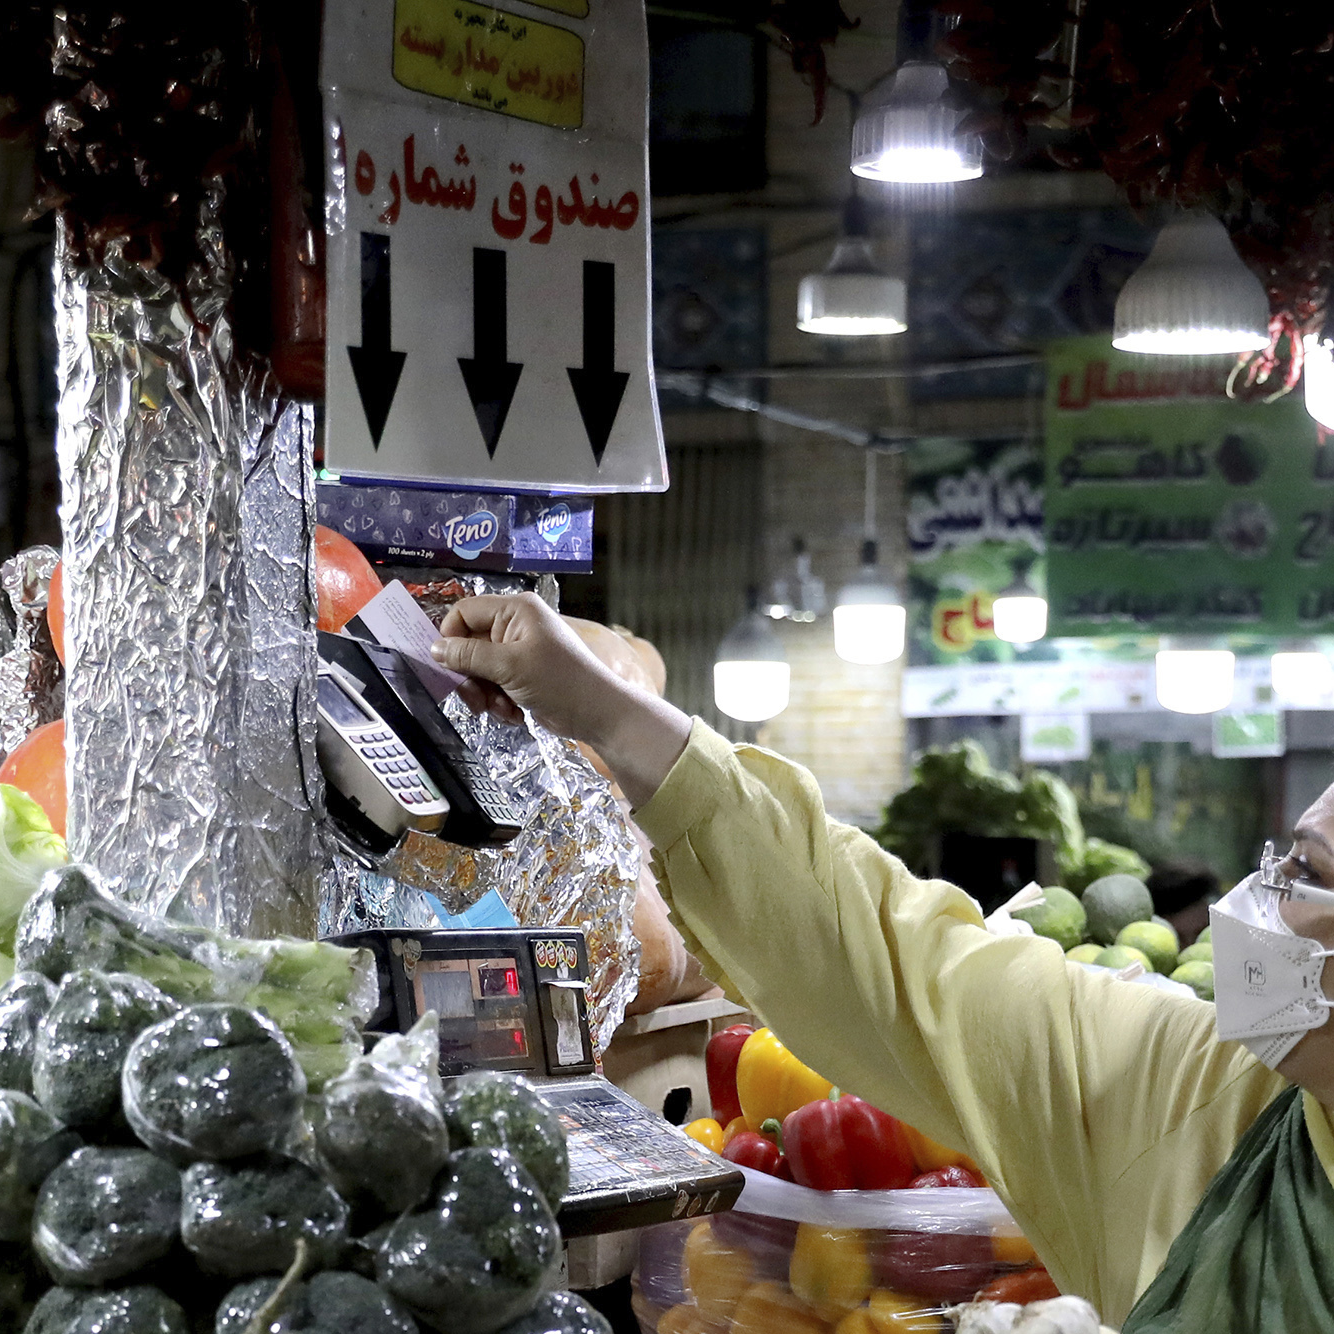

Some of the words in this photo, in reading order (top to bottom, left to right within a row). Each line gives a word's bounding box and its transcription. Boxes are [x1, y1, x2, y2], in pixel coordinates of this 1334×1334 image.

[450, 35, 500, 78] مدار
[354, 133, 477, 226] شماره
[491, 161, 640, 245] صندوق
[445, 514, 493, 549] Teno
[537, 506, 568, 536] Teno
